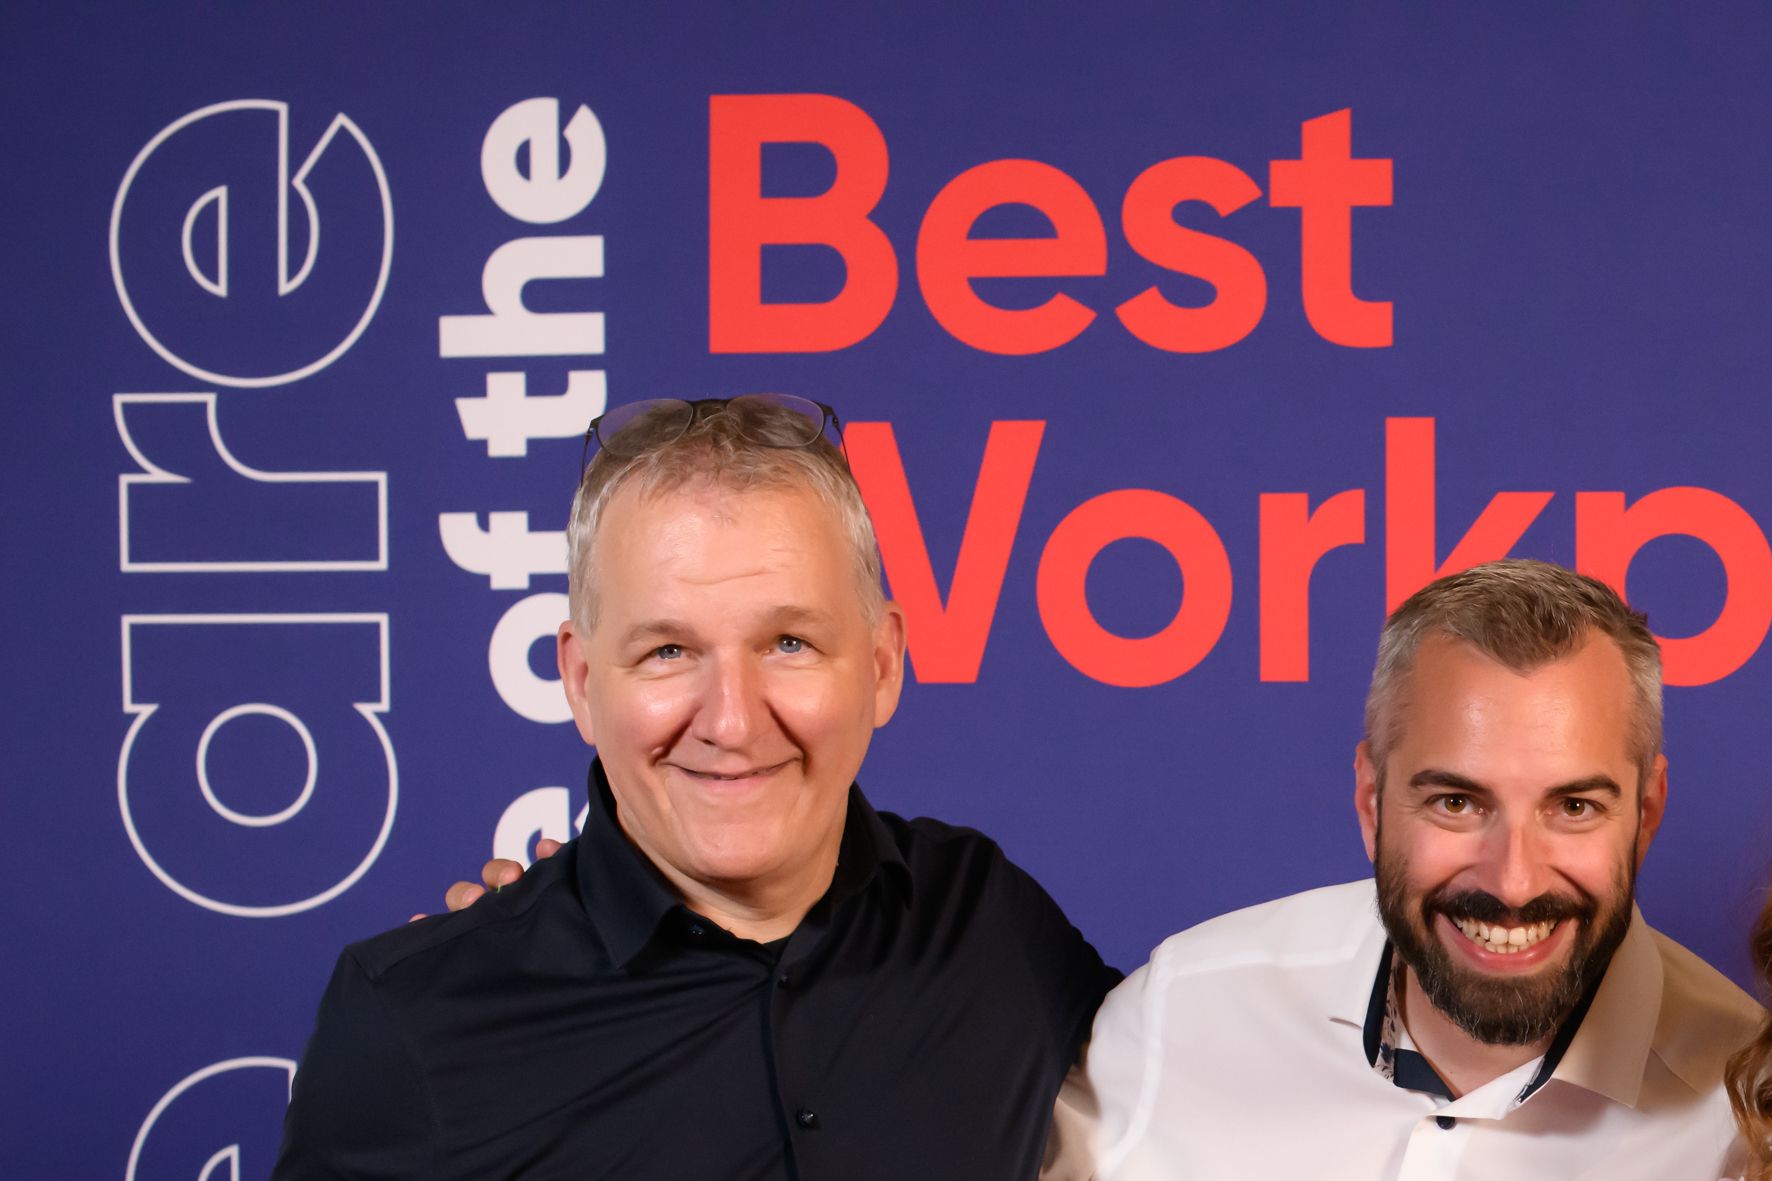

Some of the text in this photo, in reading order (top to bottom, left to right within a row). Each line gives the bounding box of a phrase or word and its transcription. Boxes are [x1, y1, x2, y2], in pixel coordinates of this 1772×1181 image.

[439, 97, 607, 457] the
[709, 93, 1394, 356] Best
[109, 98, 398, 917] are
[439, 511, 575, 724] of
